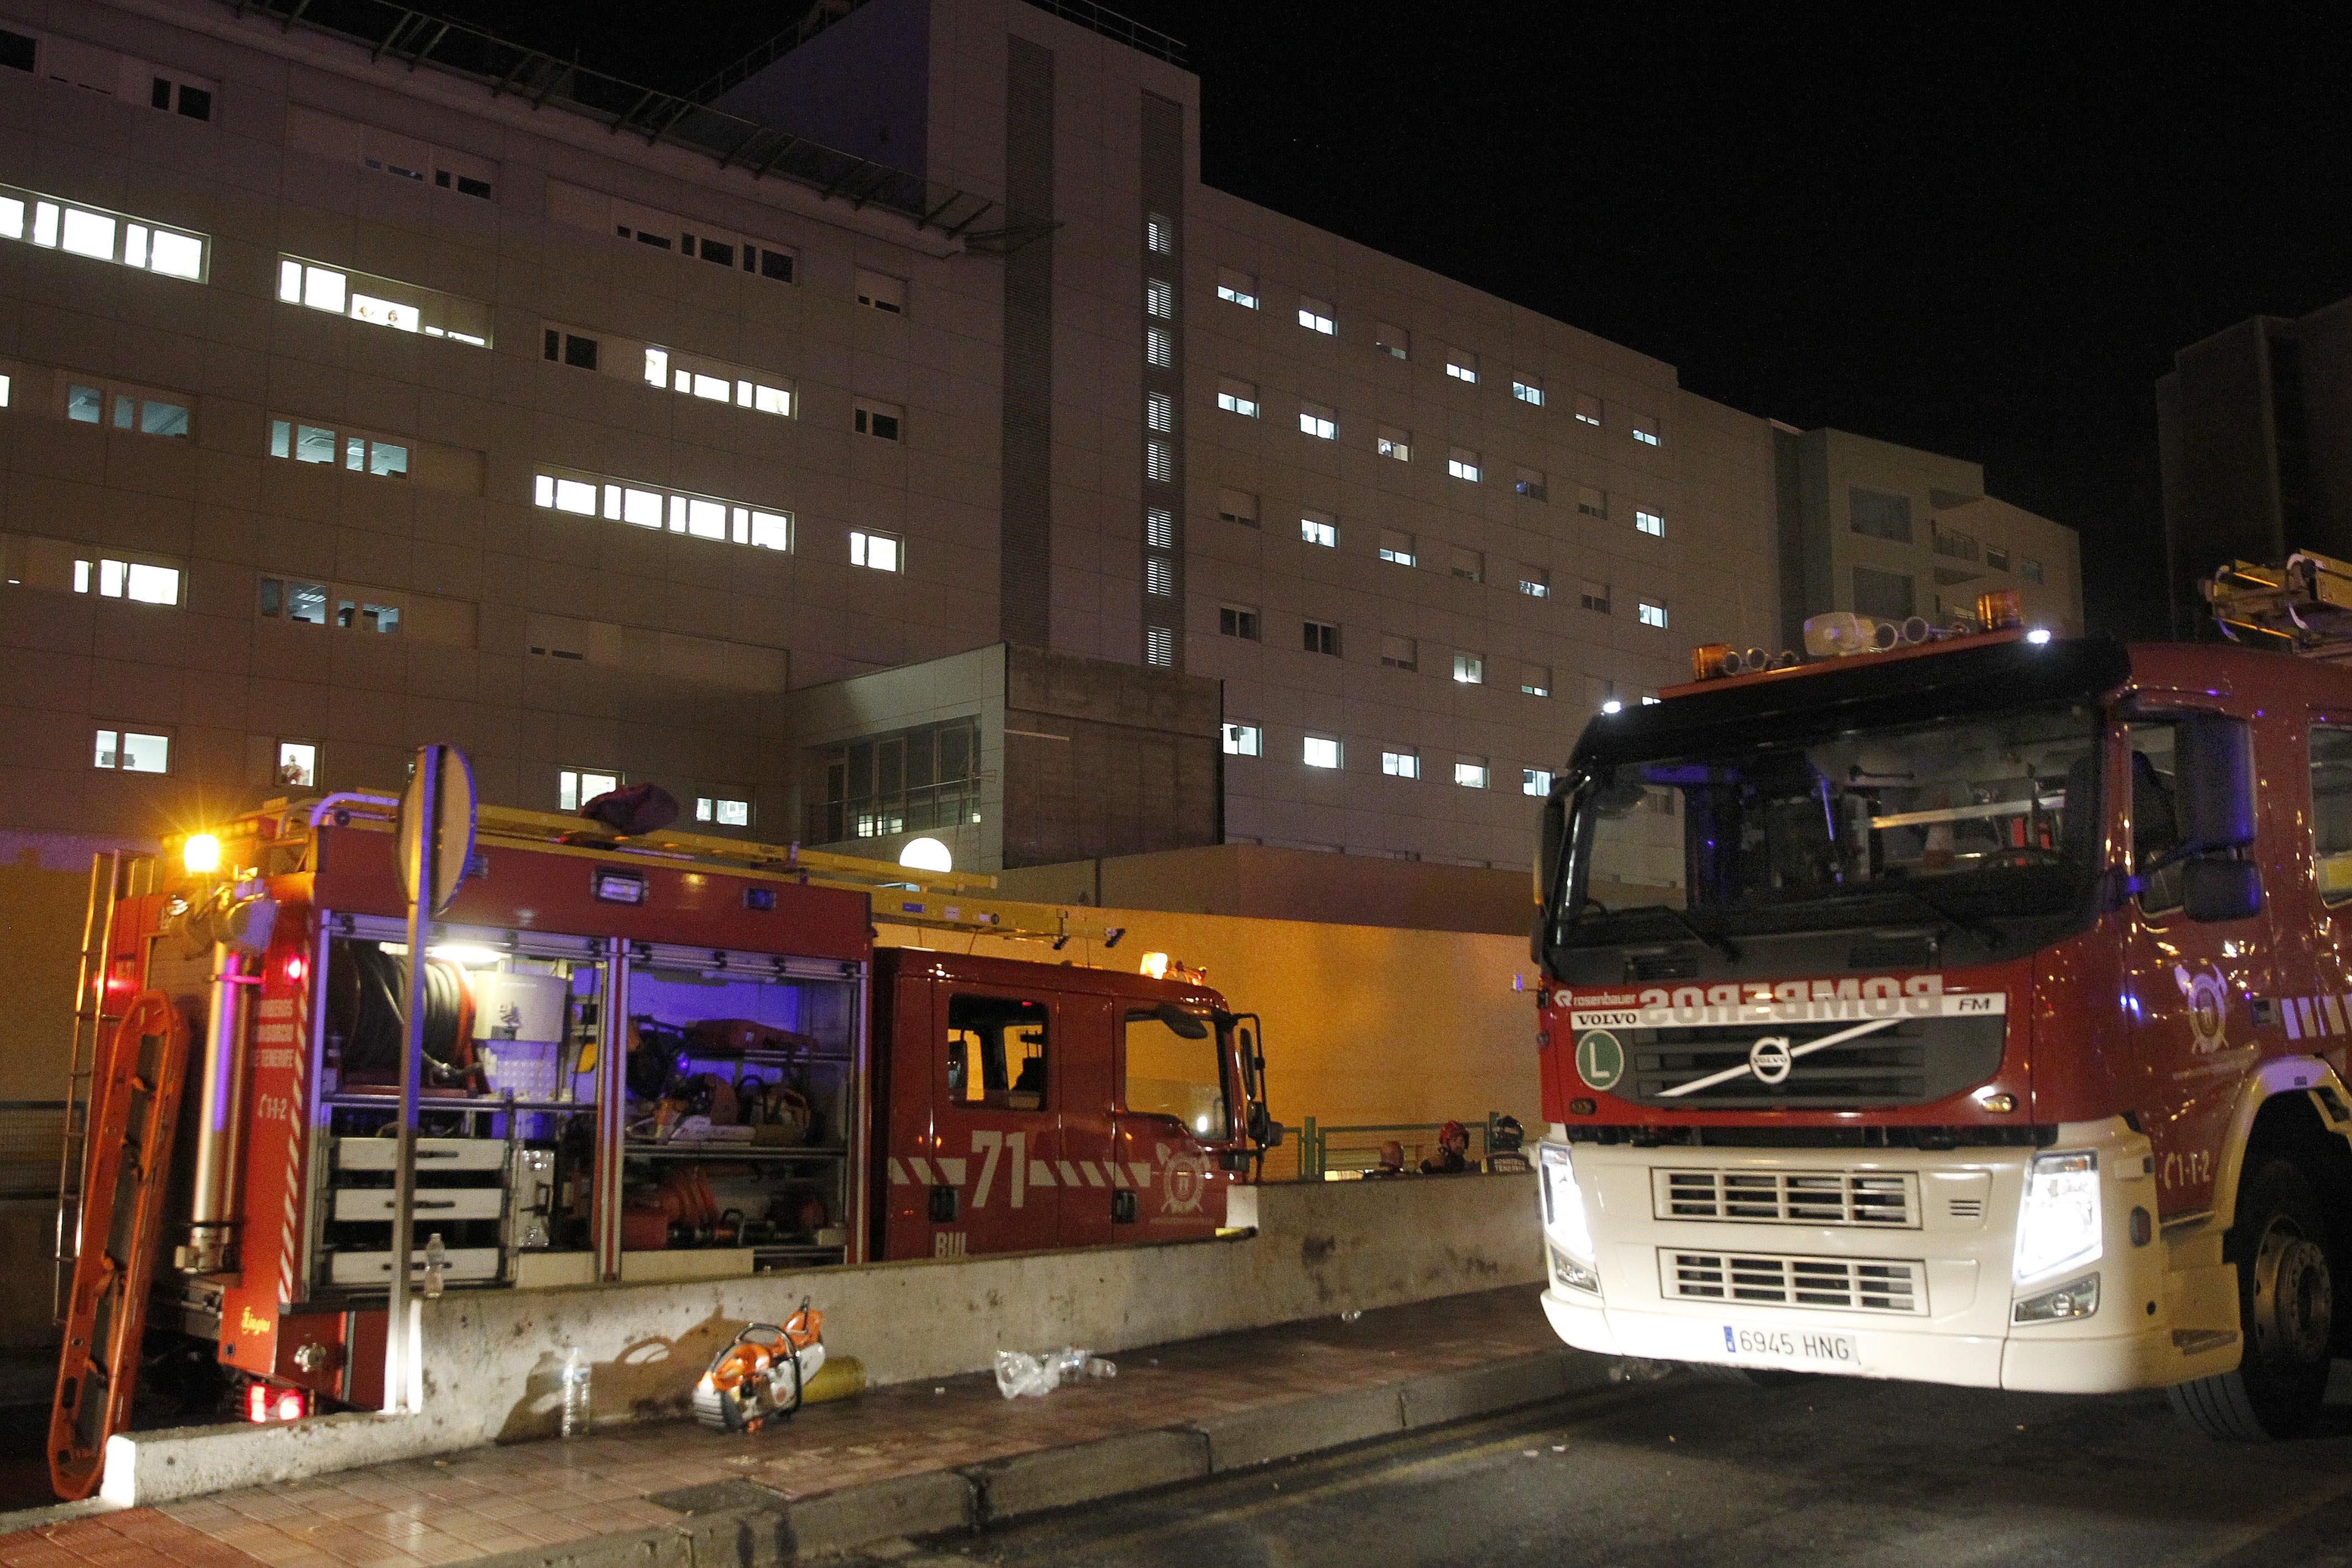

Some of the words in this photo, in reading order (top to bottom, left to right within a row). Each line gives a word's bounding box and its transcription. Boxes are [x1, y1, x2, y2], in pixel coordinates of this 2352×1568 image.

[1578, 1013, 1637, 1024] VOLVO
[1959, 997, 1990, 1010] FM
[1589, 1041, 1610, 1078] L
[971, 1130, 1026, 1208] 71
[1740, 1330, 1794, 1355] 6945
[1803, 1335, 1849, 1361] HNG
